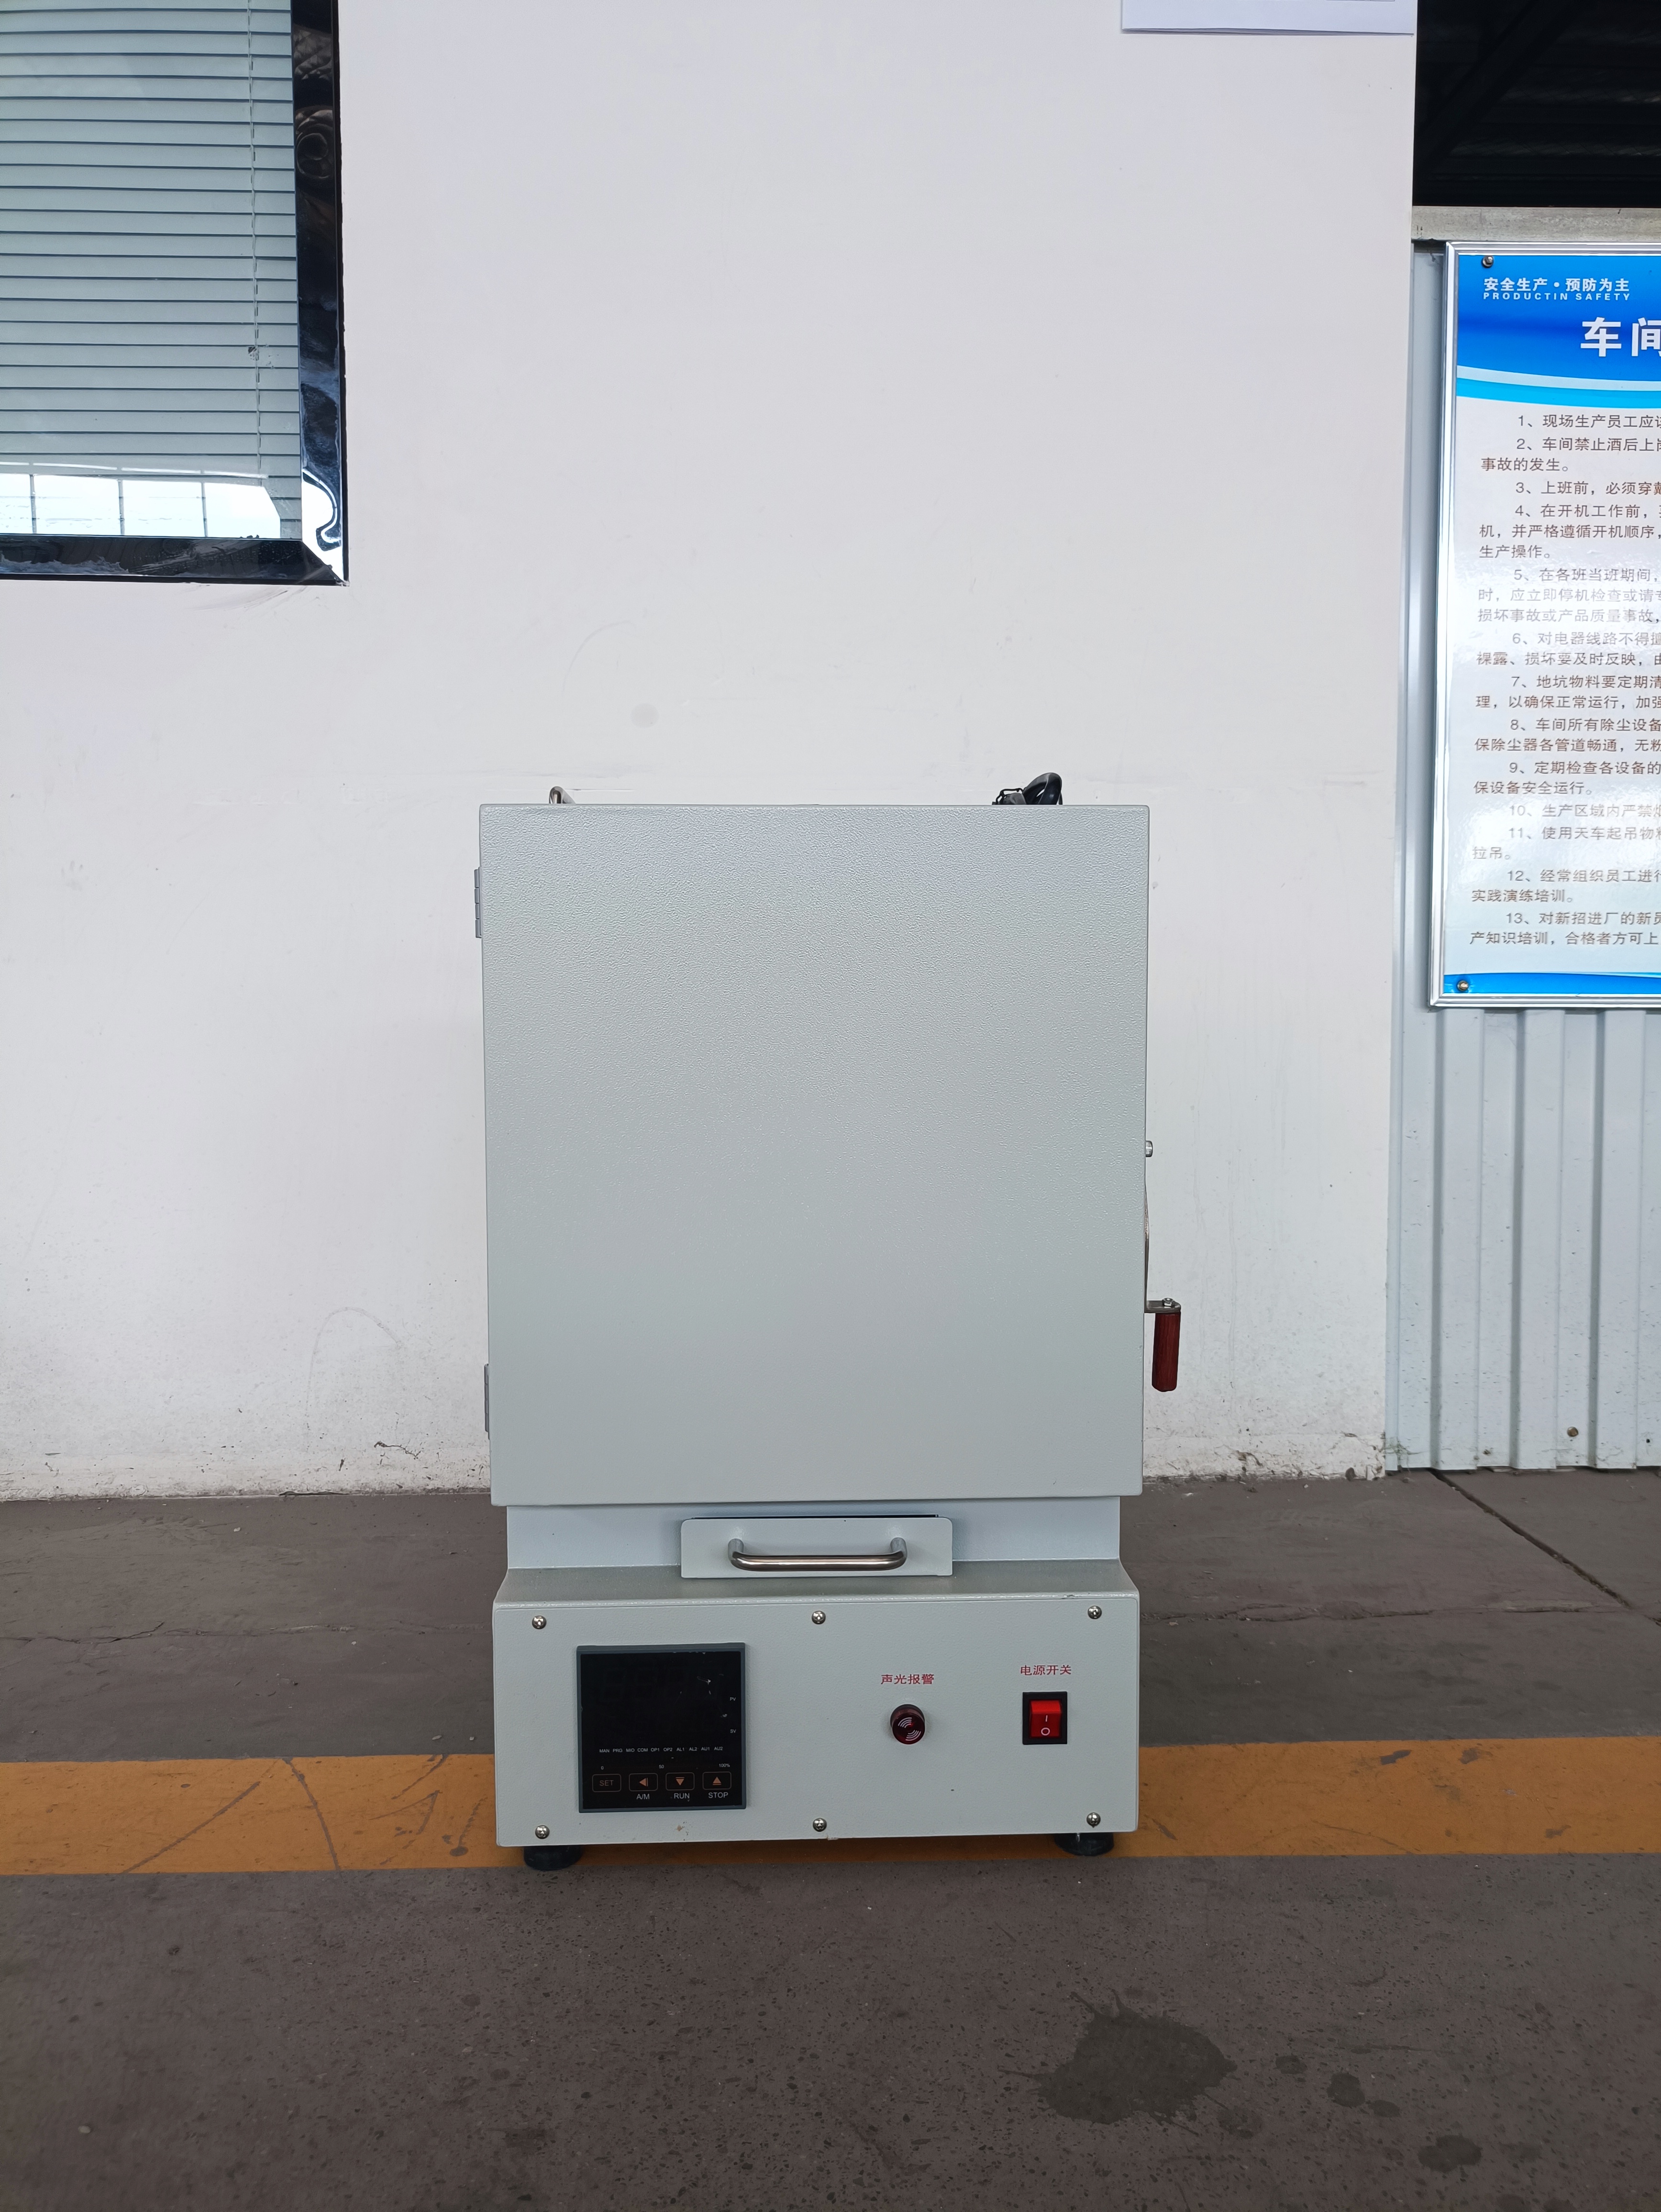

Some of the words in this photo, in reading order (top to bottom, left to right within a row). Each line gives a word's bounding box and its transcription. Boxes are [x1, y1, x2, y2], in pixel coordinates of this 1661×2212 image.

[1483, 292, 1568, 300] PRODUCTIN
[1575, 293, 1630, 301] SAFETY
[1580, 317, 1661, 357] 车间
[1481, 457, 1569, 472] 事故的发生。
[1515, 504, 1661, 519] 4、在开机工作前，
[1479, 544, 1550, 559] 生产操作。
[1473, 781, 1592, 795] 保设备安全运行。
[1472, 846, 1511, 860] 拉吊。
[1471, 889, 1573, 903] 实践演练培训。
[1469, 931, 1661, 945] 产知识培训，合格者方可上
[1020, 1665, 1072, 1676] 电源开关
[881, 1674, 934, 1685] 声光报警
